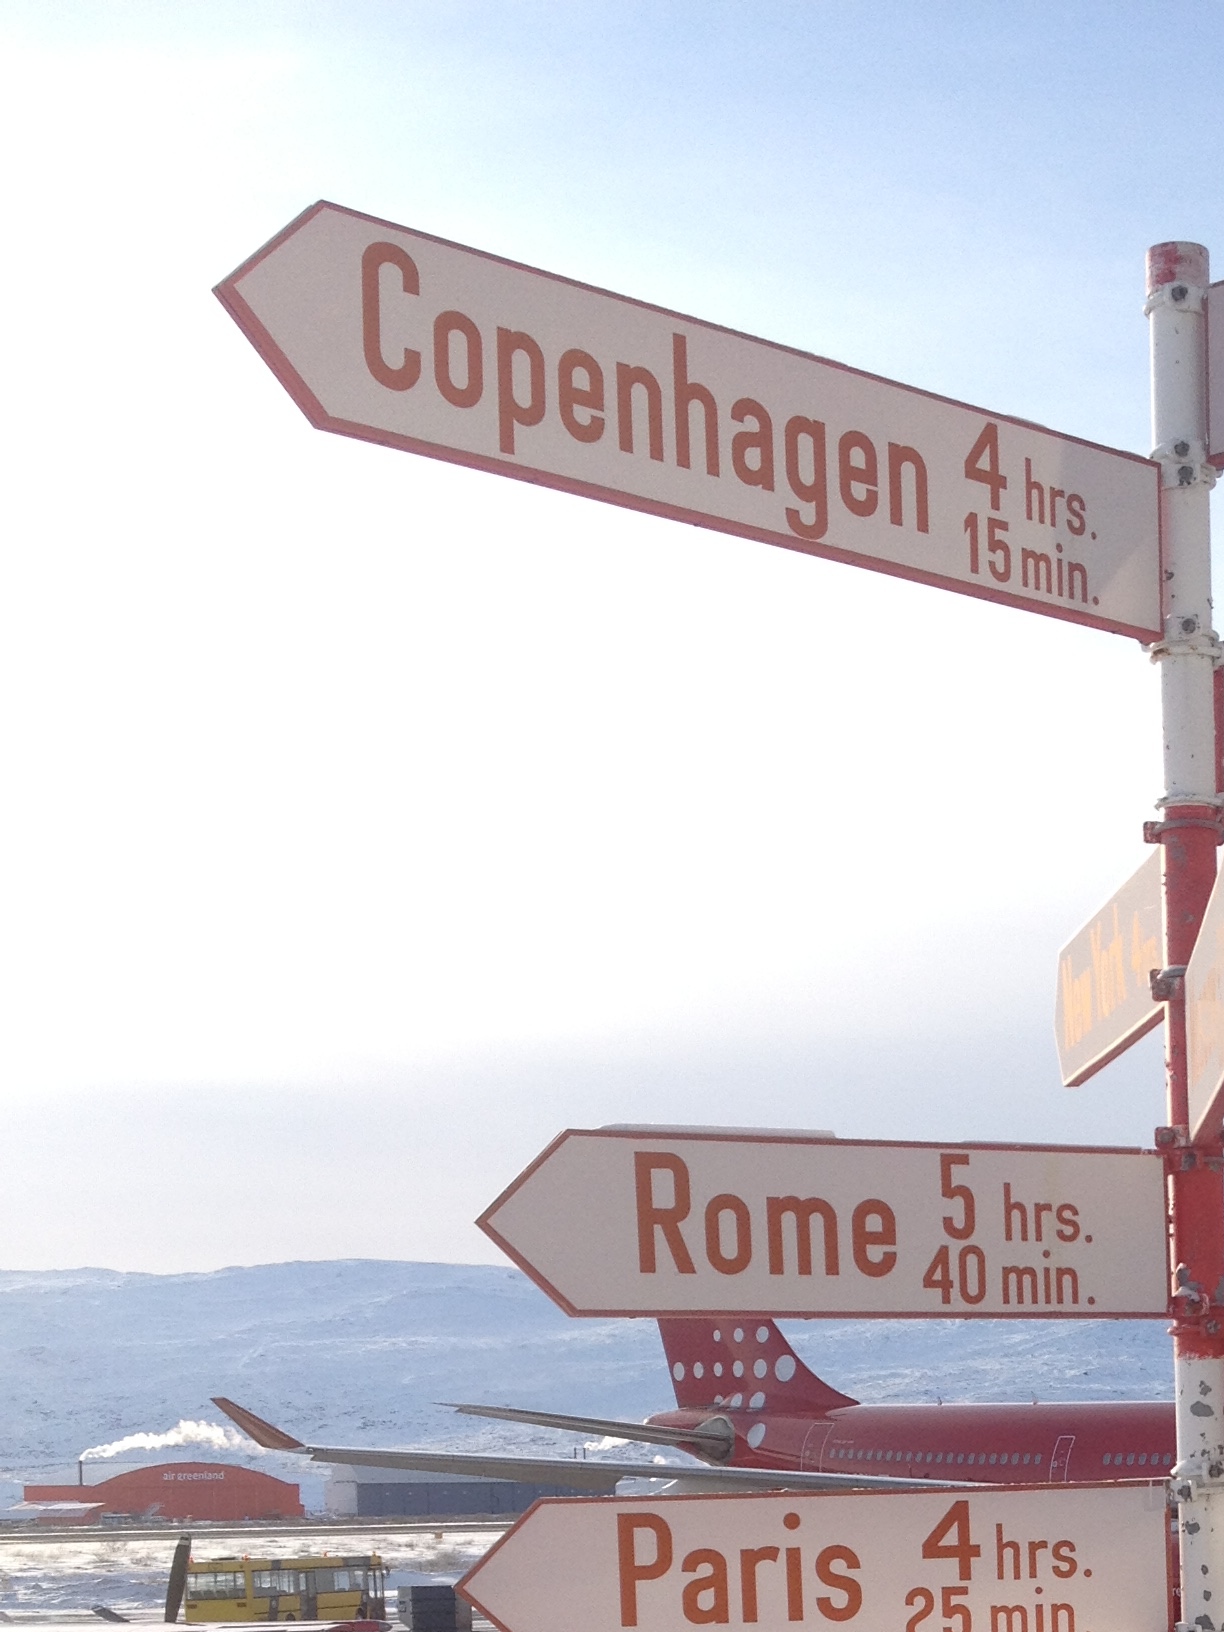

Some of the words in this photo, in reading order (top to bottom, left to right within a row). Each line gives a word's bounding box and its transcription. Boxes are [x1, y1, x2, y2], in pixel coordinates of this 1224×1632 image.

[360, 241, 930, 541] Copenhagen
[963, 422, 1007, 511] 4
[1023, 456, 1099, 541] hrs.
[962, 510, 1013, 583] 15
[1020, 542, 1101, 605] min.
[634, 1151, 898, 1279] Rome
[939, 1153, 977, 1242] 5
[1003, 1182, 1094, 1244] hrs.
[922, 1245, 988, 1306] 40
[1001, 1250, 1096, 1306] min.
[162, 1471, 176, 1480] air
[177, 1471, 224, 1481] greenland
[616, 1511, 865, 1630] Paris
[920, 1500, 982, 1583] 4
[995, 1522, 1094, 1581] hrs.
